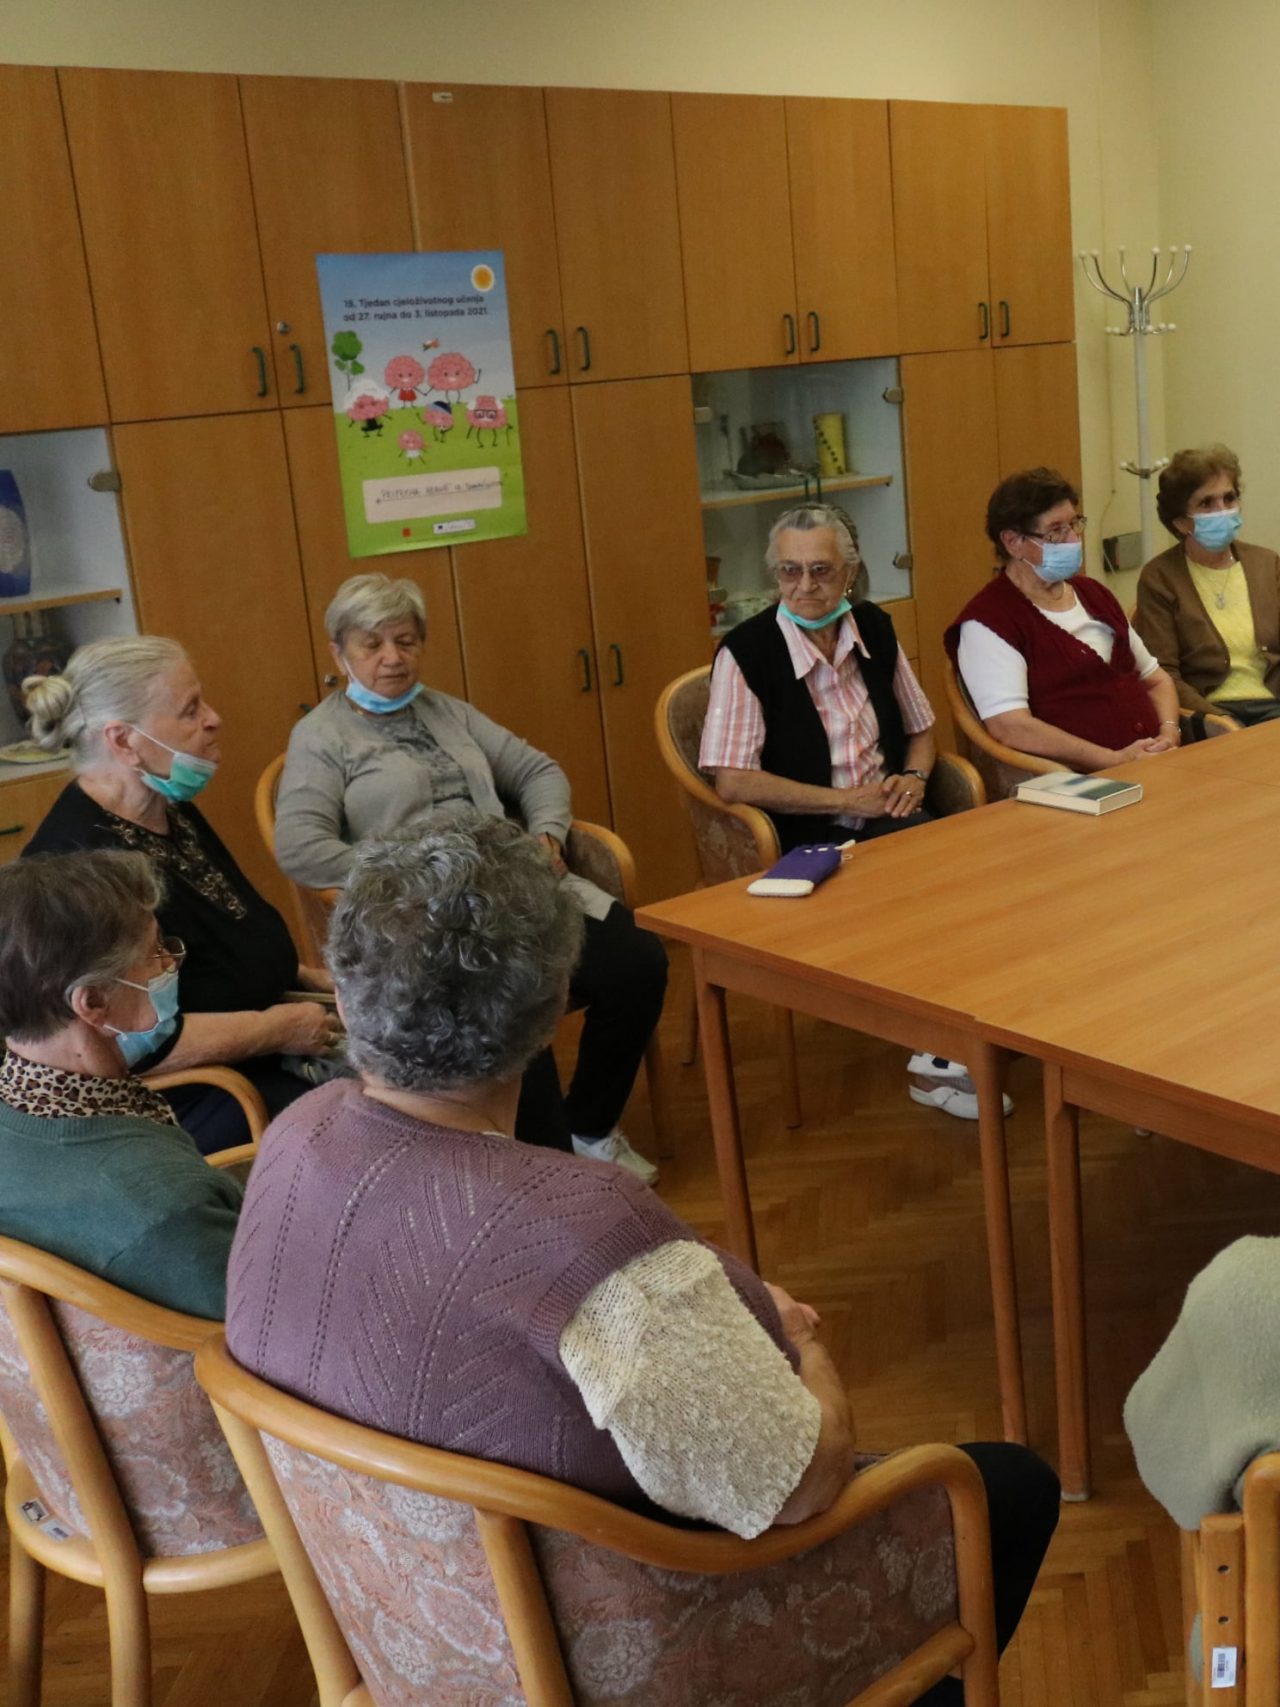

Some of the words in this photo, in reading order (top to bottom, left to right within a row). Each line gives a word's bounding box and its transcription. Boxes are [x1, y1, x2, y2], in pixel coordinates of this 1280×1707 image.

[359, 297, 391, 309] Tjedan
[392, 296, 454, 308] cjeloživotnog
[456, 294, 484, 305] učenja
[343, 312, 356, 322] od
[374, 311, 398, 321] rujna
[399, 310, 411, 319] do
[424, 307, 465, 318] listopada
